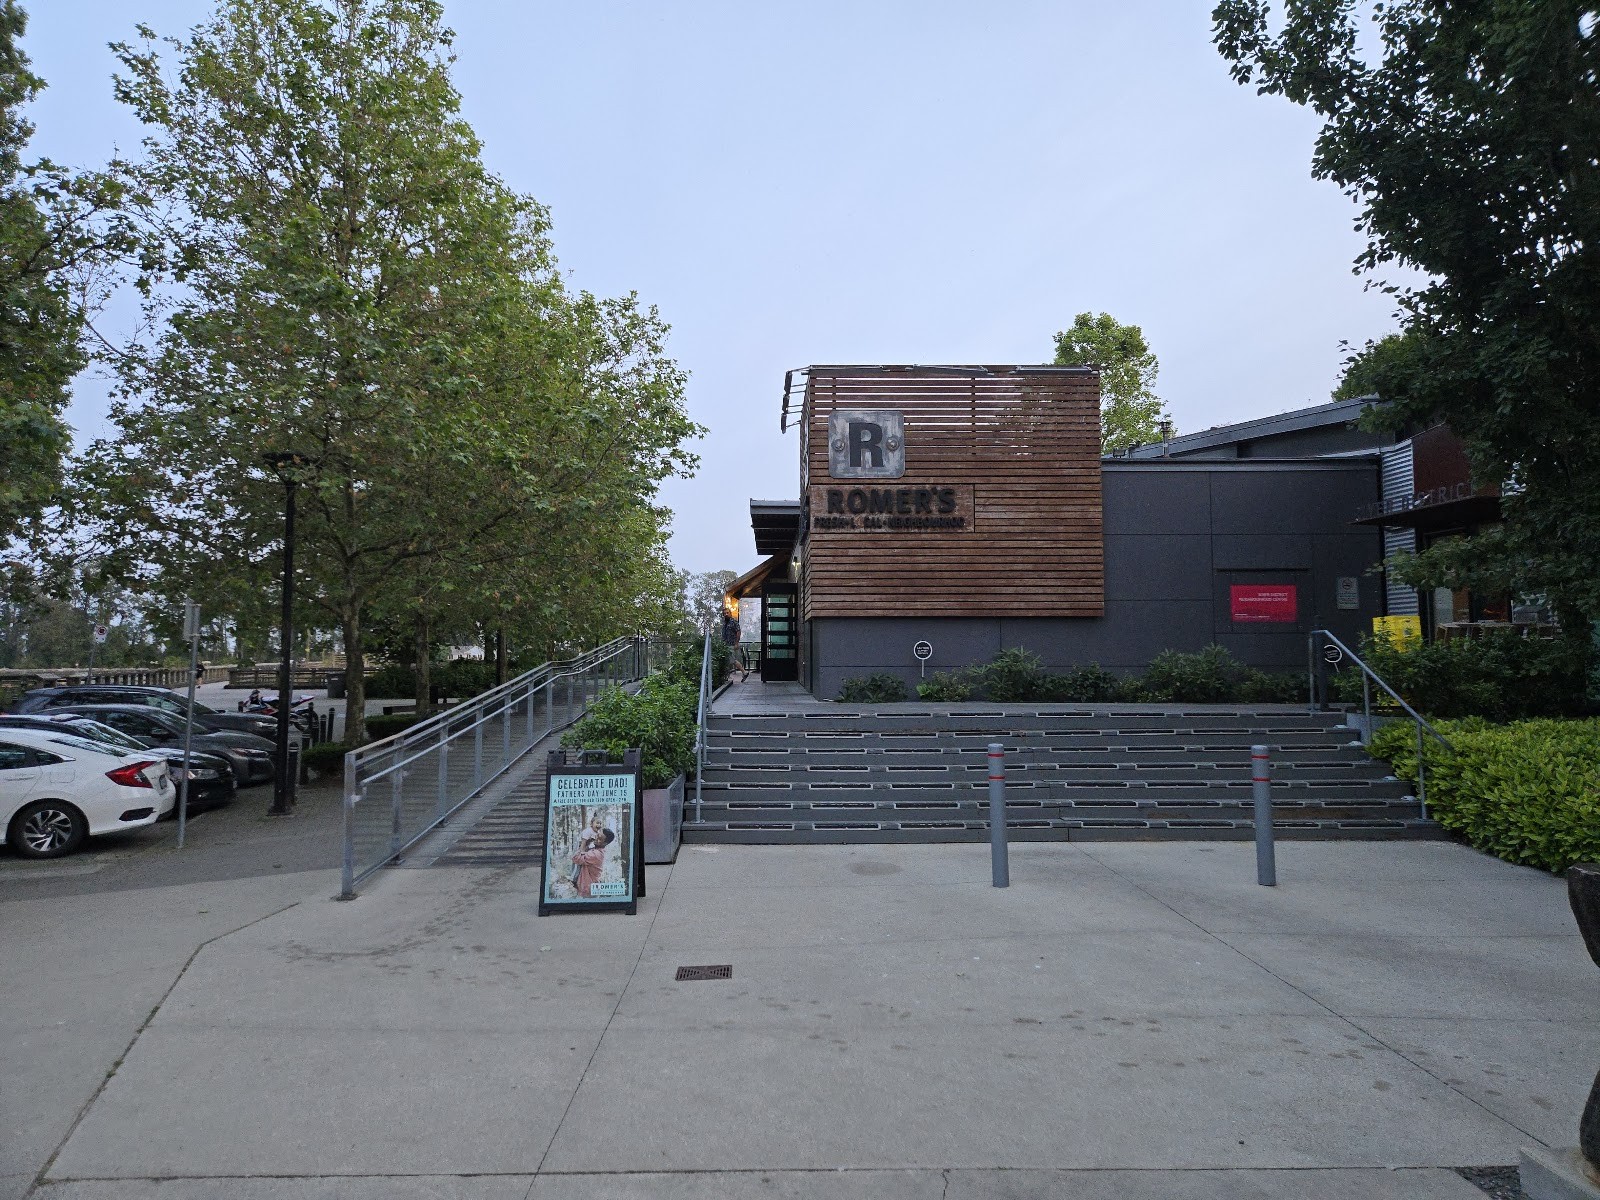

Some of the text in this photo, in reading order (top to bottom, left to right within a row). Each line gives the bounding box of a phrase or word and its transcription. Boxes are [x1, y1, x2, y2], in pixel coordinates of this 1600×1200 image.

[849, 422, 885, 468] R
[827, 487, 956, 515] ROMER'S
[558, 778, 628, 790] CELEBRATE DAD!
